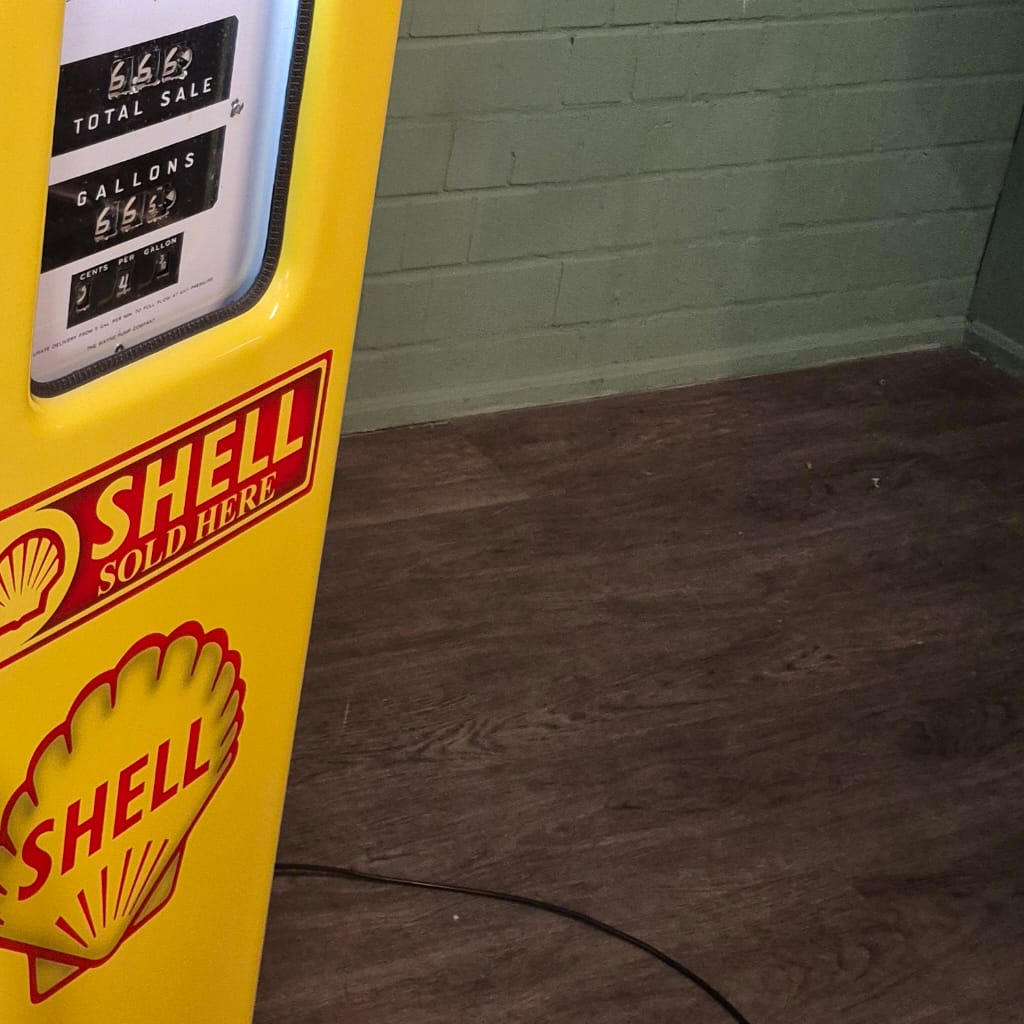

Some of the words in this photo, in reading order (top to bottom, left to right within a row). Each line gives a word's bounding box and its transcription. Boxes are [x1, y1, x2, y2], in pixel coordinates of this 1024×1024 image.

[73, 100, 143, 134] TOTAL
[160, 77, 214, 107] SALE
[77, 152, 195, 207] GALLONS
[79, 264, 109, 281] CENTS
[118, 254, 135, 266] PER
[143, 237, 177, 256] GALLON
[90, 389, 304, 560] SHELL
[97, 524, 188, 597] SOLD
[193, 472, 277, 541] HERE
[18, 717, 210, 902] SHELL
